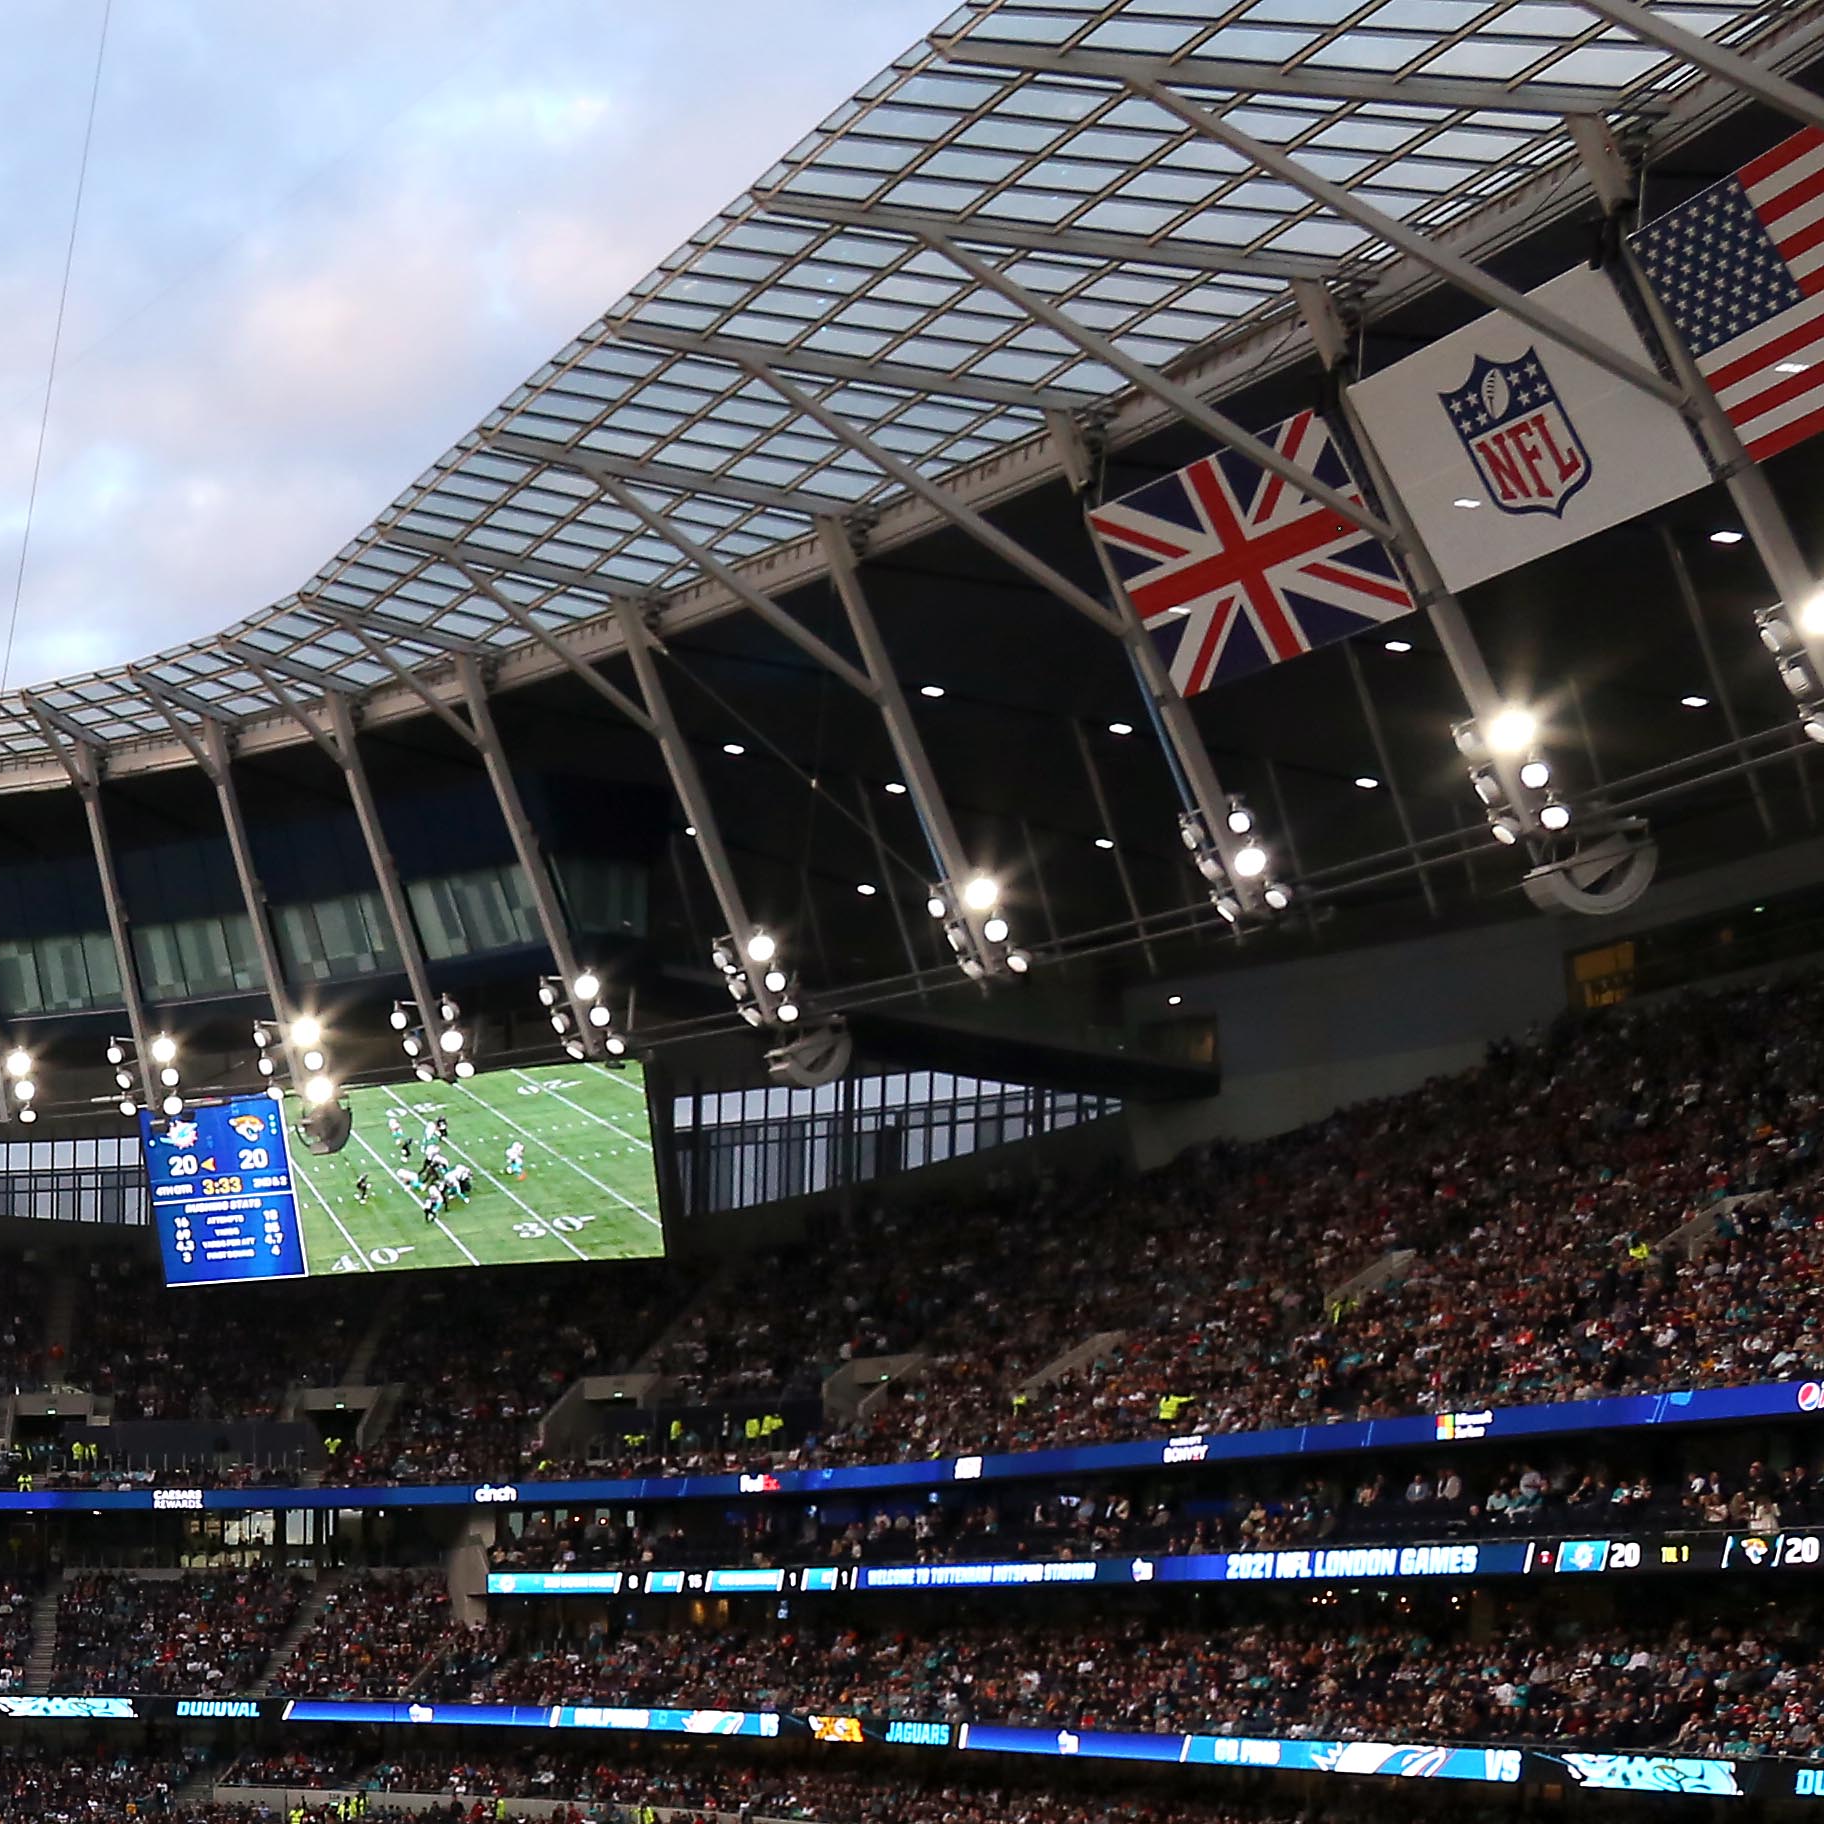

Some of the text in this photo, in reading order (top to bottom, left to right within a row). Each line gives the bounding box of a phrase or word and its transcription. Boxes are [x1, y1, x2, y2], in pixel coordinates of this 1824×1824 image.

[1476, 415, 1581, 500] NFL
[169, 1154, 198, 1176] 20
[238, 1148, 269, 1170] 20
[203, 1176, 244, 1195] 3:33
[264, 1232, 284, 1245] 4.7
[475, 1483, 517, 1502] cinch
[740, 1474, 781, 1492] FedEx
[153, 1489, 203, 1500] CAESARS
[1610, 1542, 1640, 1568] 20
[1785, 1537, 1820, 1564] 20
[1225, 1546, 1479, 1579] 2021 NFL LONDON GAMES
[177, 1701, 260, 1717] DUUUVAL
[761, 1713, 779, 1738] VS
[885, 1720, 949, 1745] JAGUARS
[1485, 1748, 1522, 1782] VS
